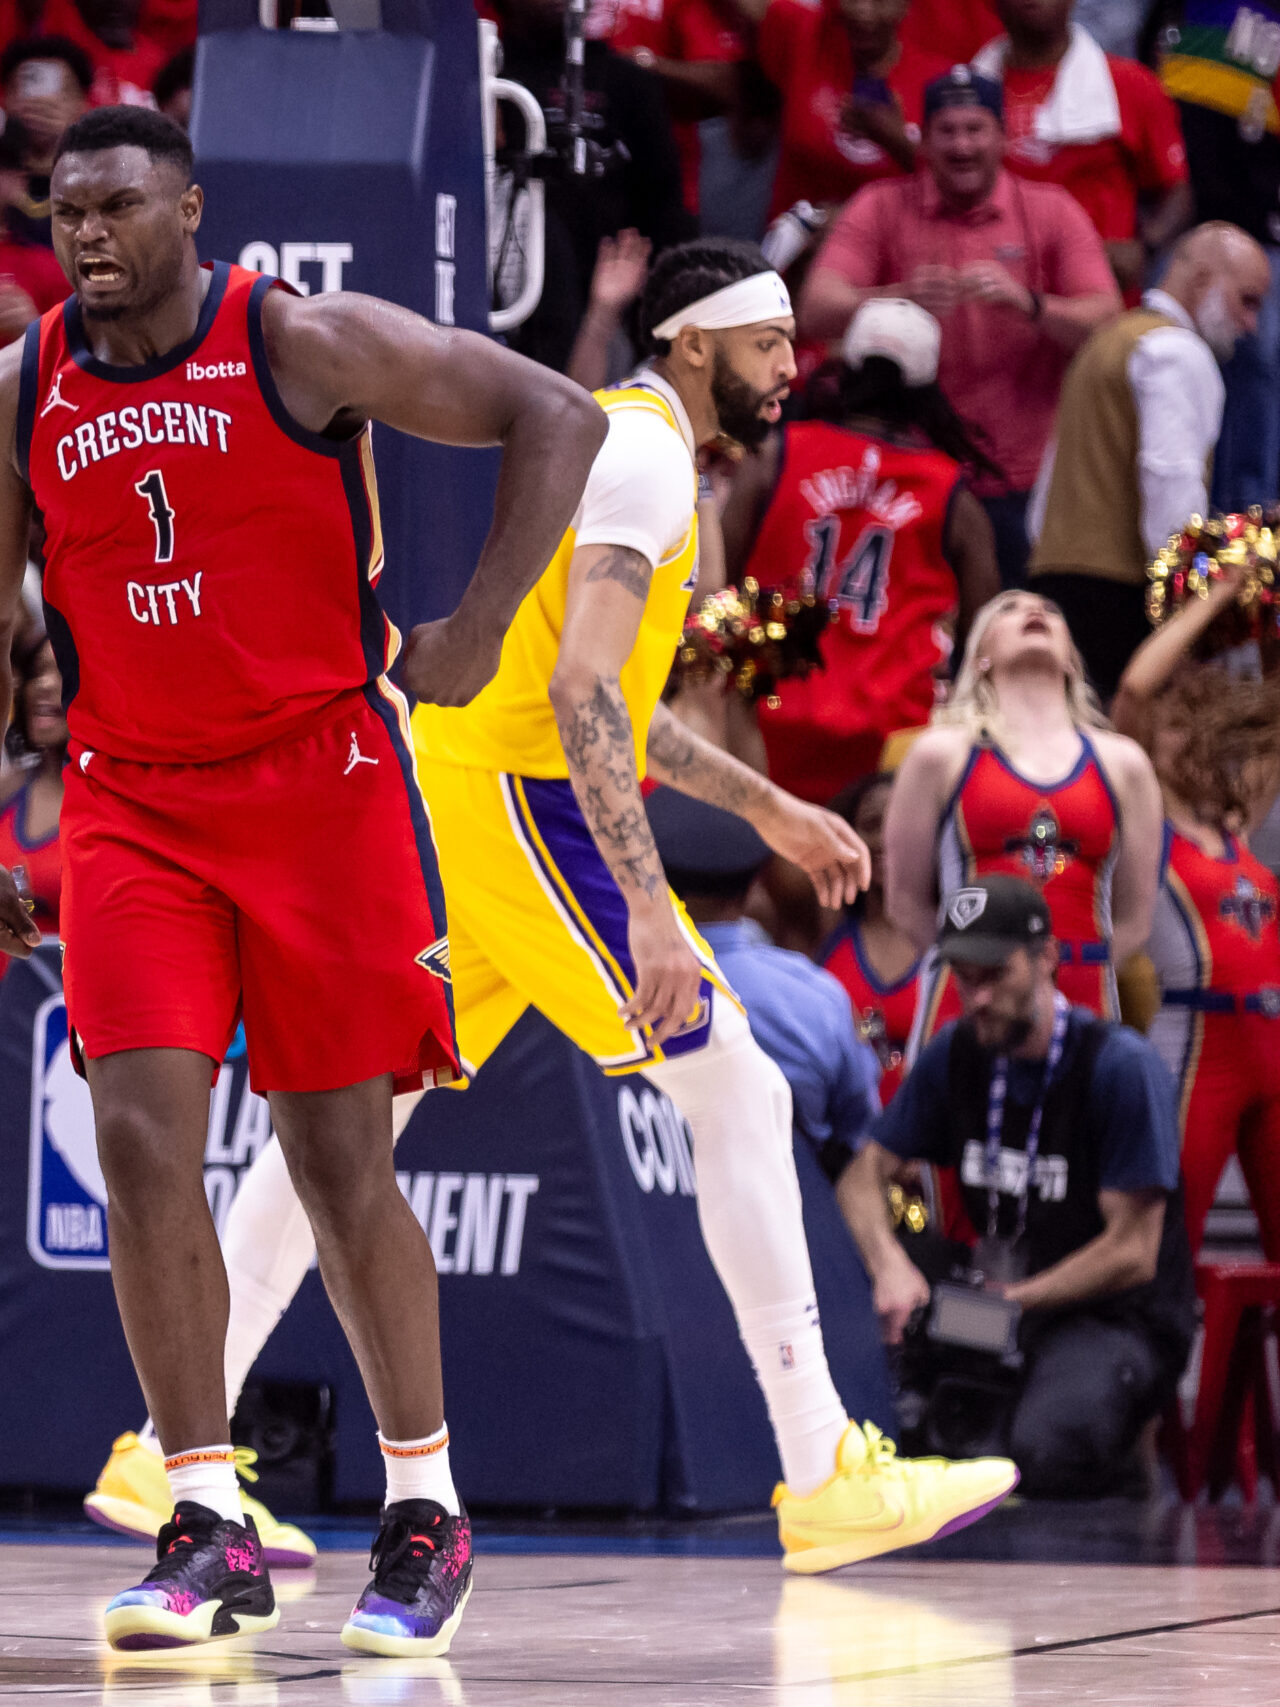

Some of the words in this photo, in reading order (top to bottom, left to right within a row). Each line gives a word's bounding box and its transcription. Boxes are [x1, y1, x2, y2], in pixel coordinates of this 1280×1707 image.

[186, 361, 246, 381] ibotta
[56, 401, 232, 482] CRESCENT
[134, 469, 175, 563] 1
[126, 570, 202, 626] CITY
[802, 513, 895, 636] 14
[45, 1202, 104, 1251] NBA
